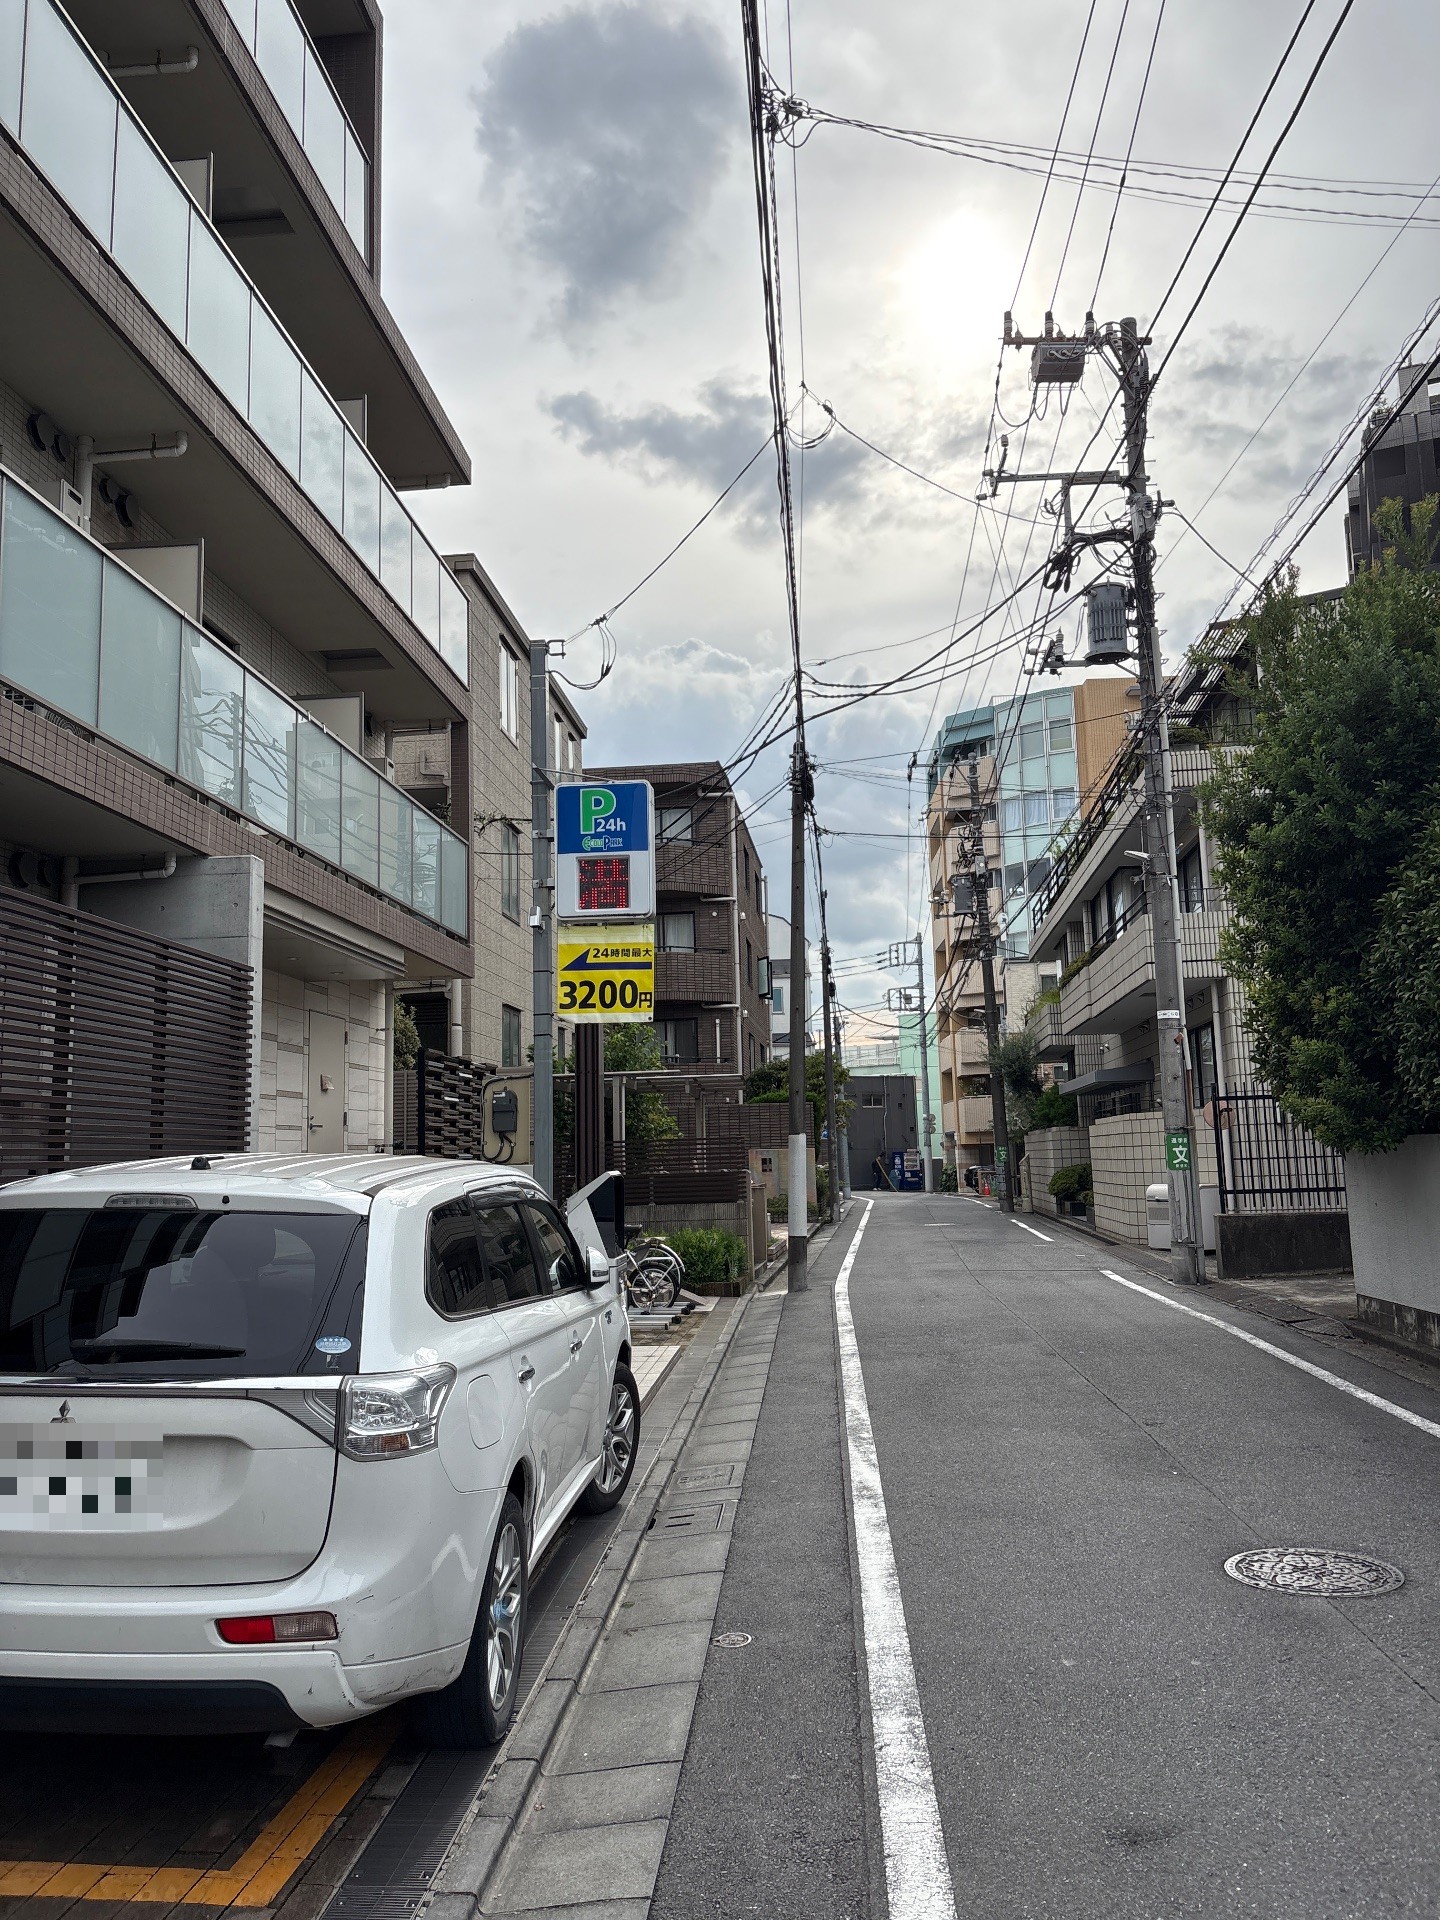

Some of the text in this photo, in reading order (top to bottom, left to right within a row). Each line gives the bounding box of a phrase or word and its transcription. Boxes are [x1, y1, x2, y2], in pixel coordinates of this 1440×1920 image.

[580, 788, 616, 835] P
[596, 817, 626, 832] 24h
[592, 947, 652, 959] 24時間最大
[559, 980, 652, 1010] 3200円
[1172, 1145, 1188, 1163] 文
